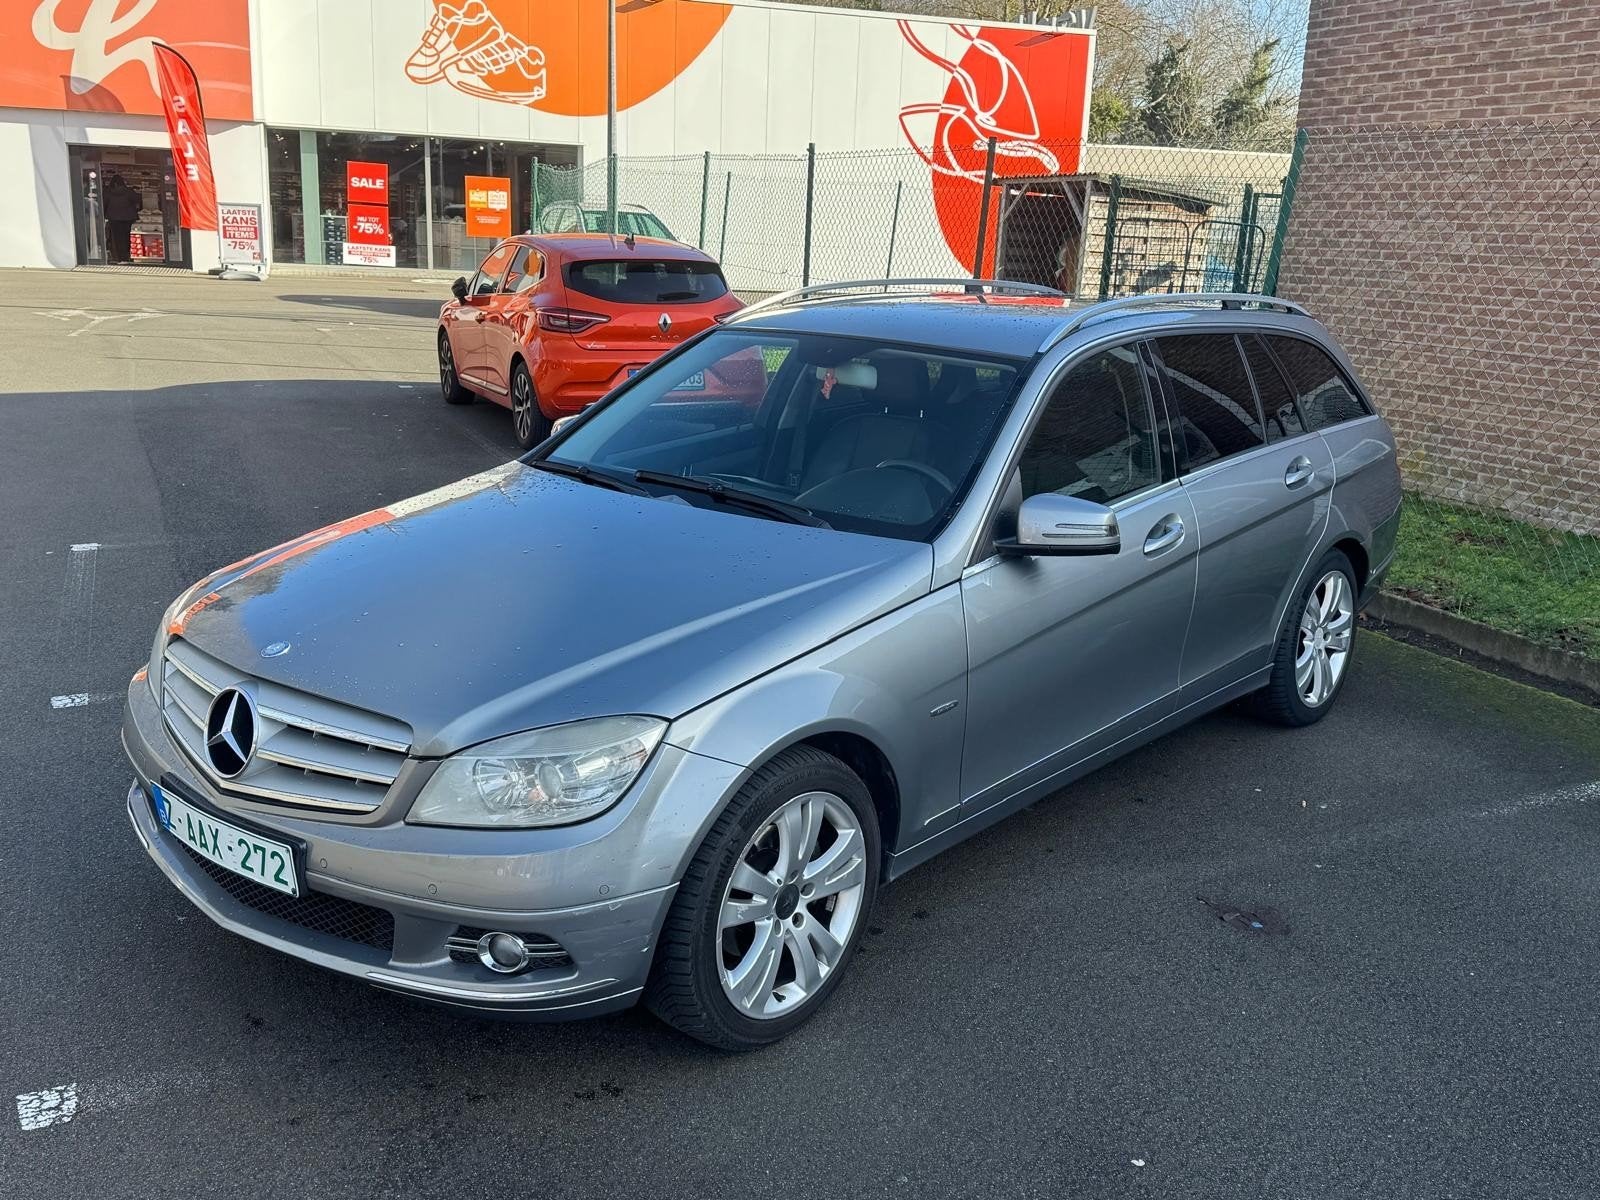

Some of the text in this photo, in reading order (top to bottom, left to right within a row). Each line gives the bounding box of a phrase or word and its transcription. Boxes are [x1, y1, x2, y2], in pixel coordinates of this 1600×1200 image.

[351, 177, 385, 190] SALE
[222, 216, 257, 225] KANS
[353, 222, 384, 235] -75%
[228, 241, 255, 250] -75%
